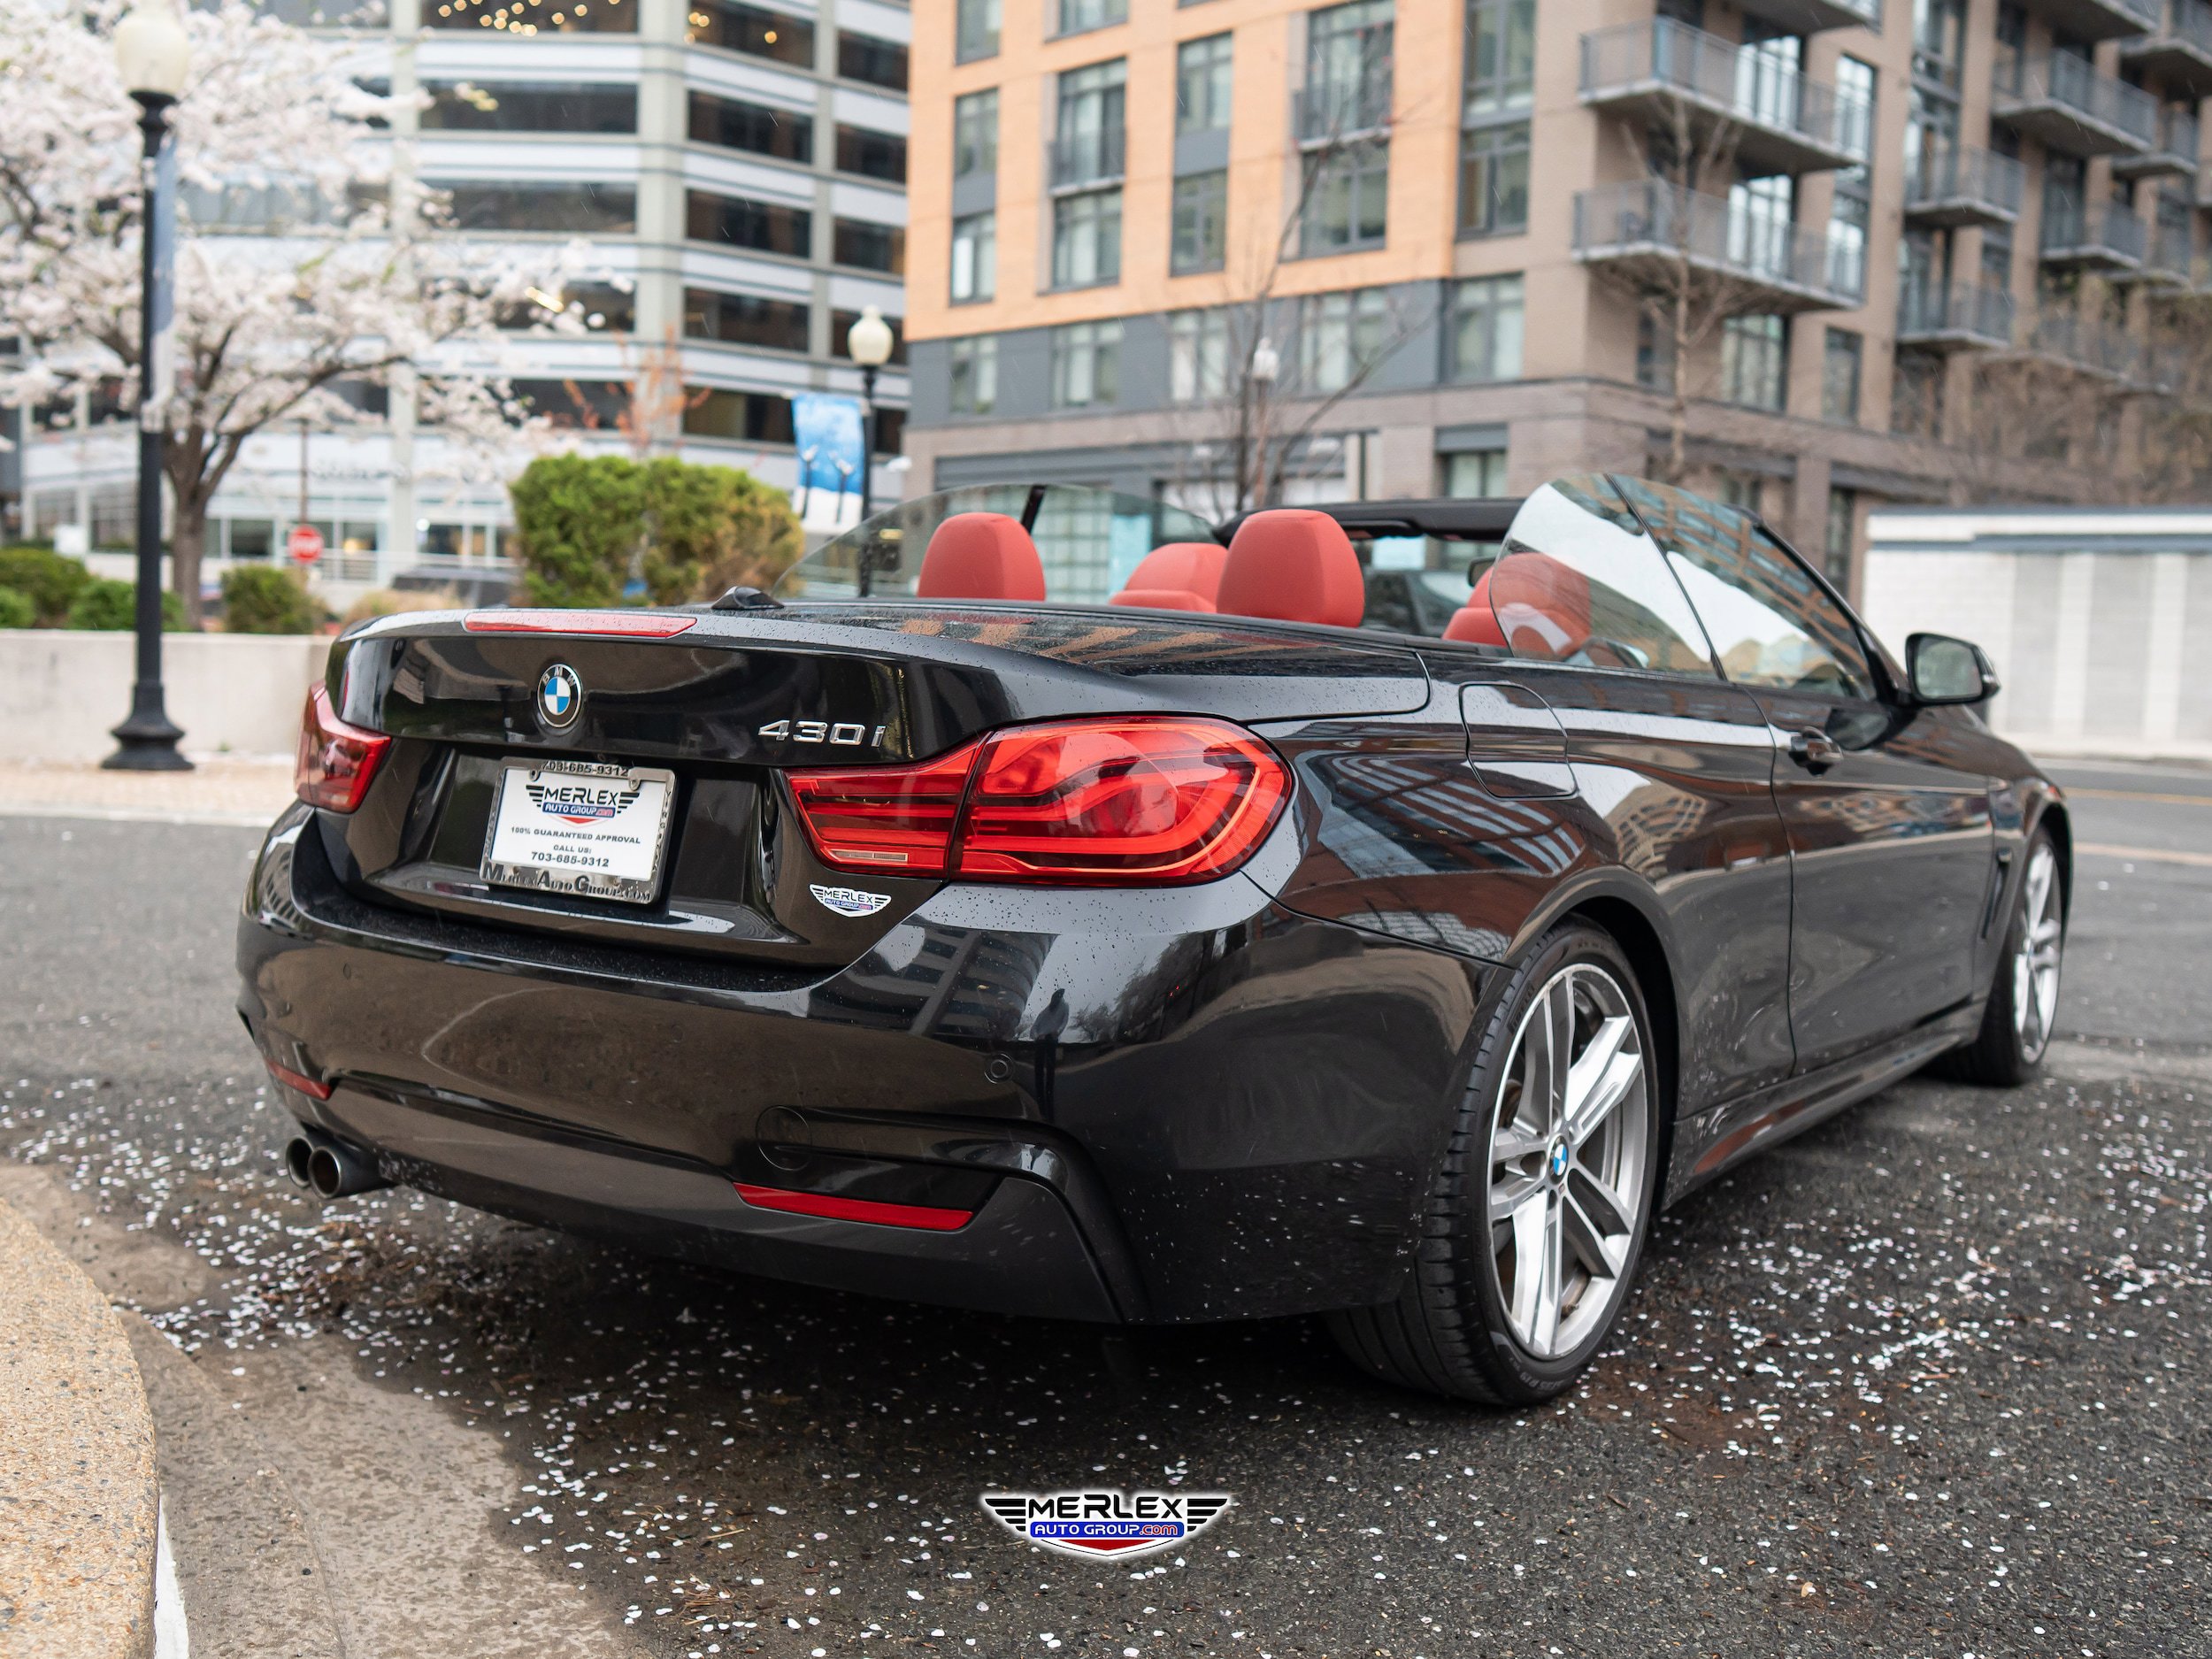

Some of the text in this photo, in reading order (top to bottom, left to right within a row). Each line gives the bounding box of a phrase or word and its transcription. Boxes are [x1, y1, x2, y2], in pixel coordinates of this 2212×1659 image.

[541, 666, 578, 687] BMW
[758, 719, 887, 748] 430i
[545, 787, 618, 806] MERLEX
[545, 804, 568, 813] AUTO
[534, 829, 593, 841] GUARANTEED
[595, 834, 641, 844] APPROVAL
[553, 844, 575, 853] CALL
[531, 851, 610, 868] 703-685-9312
[824, 889, 873, 903] MERLEX
